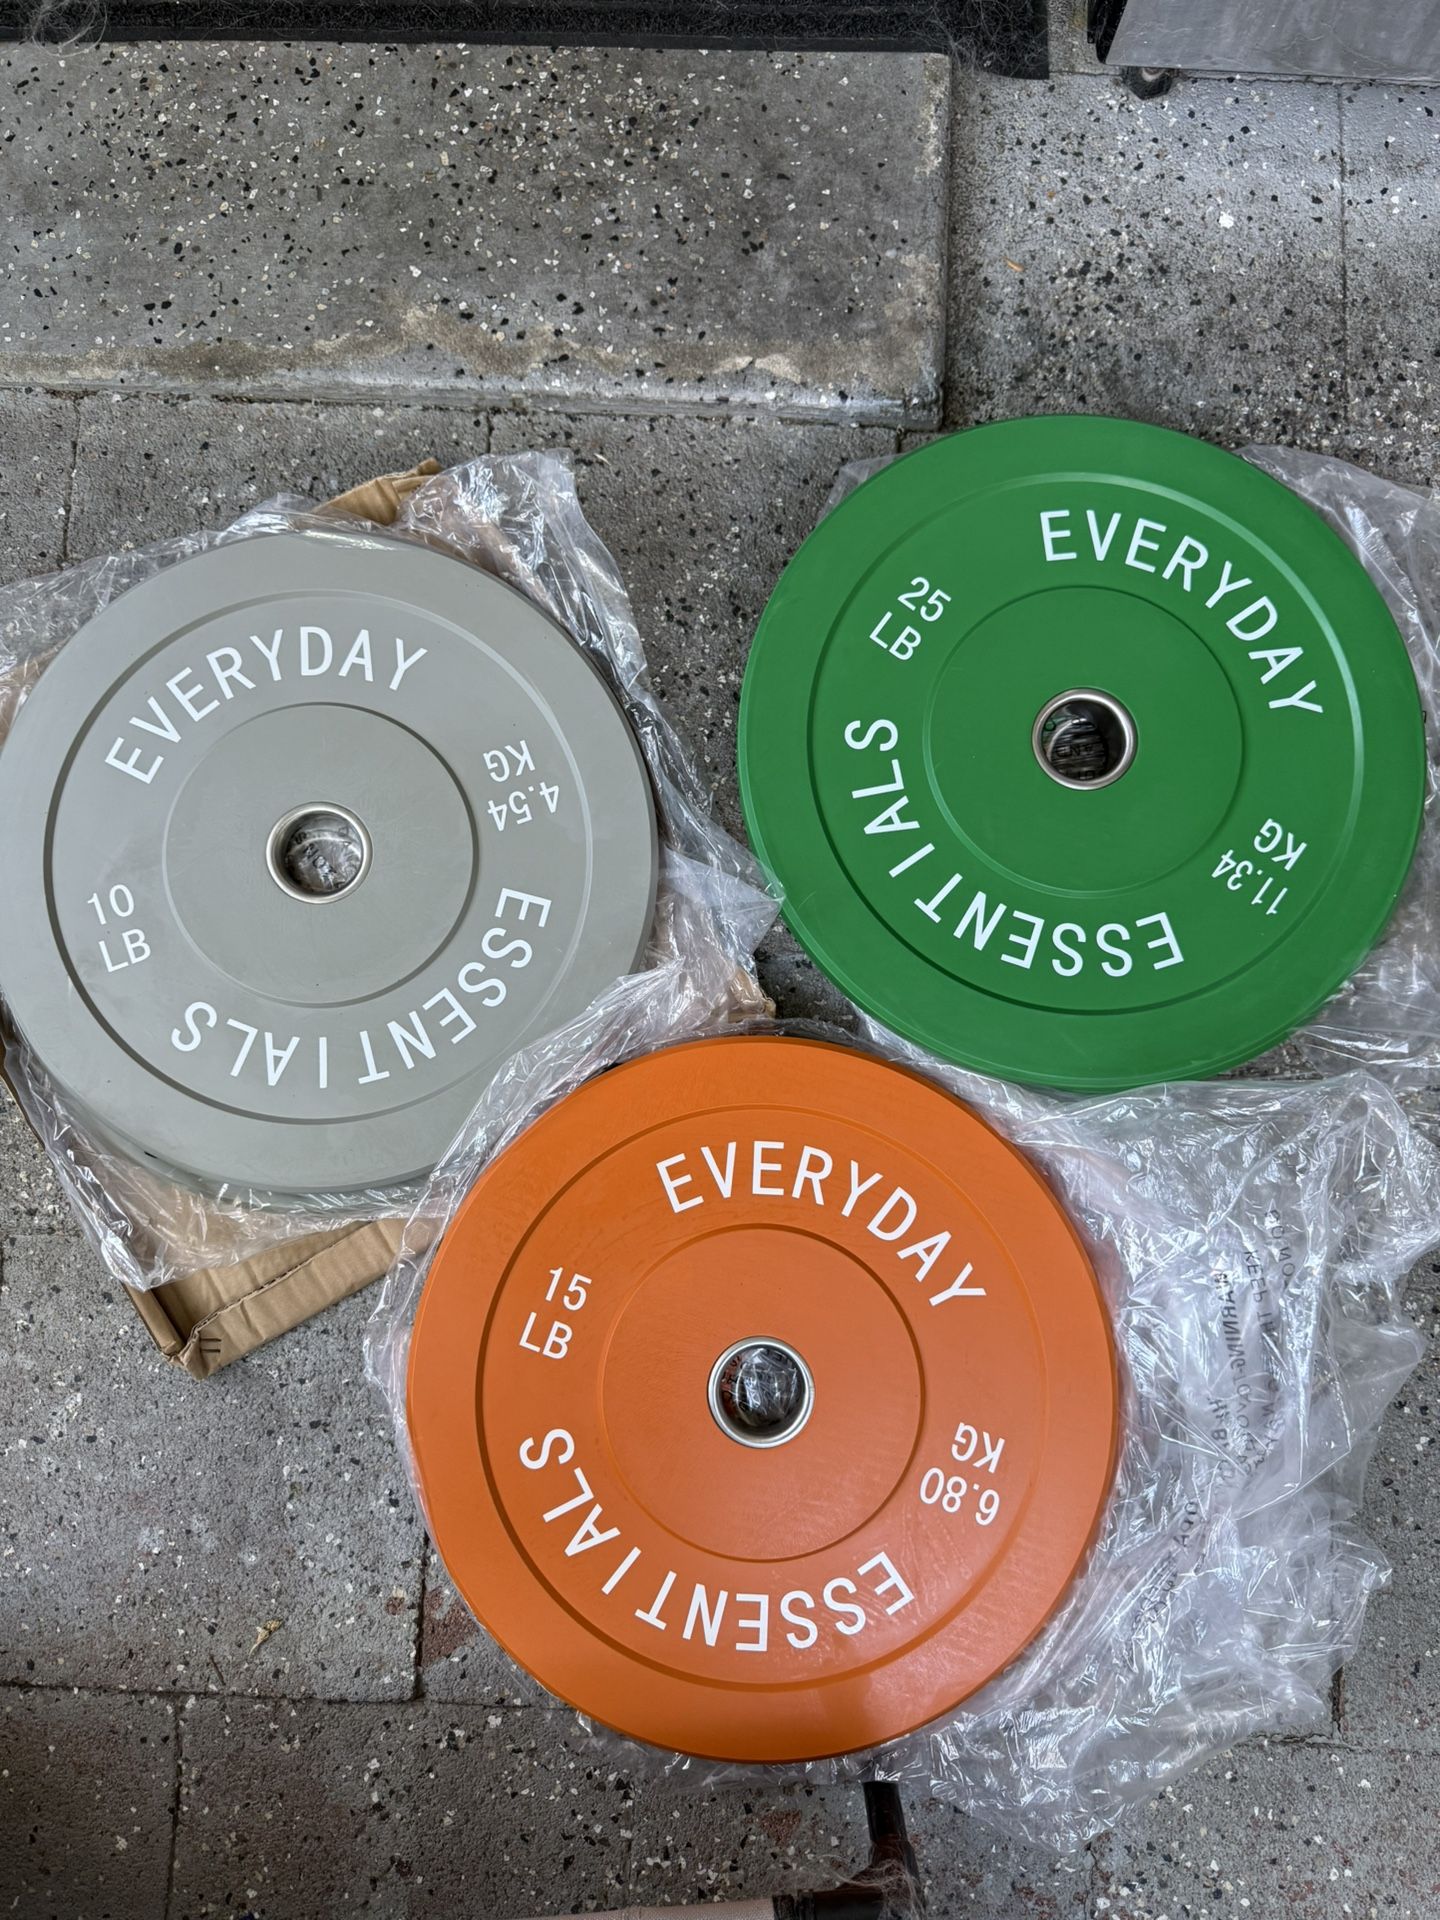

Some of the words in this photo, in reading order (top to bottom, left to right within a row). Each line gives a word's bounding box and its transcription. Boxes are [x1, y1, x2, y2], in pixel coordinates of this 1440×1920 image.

[897, 576, 952, 622] 25
[1040, 510, 1323, 713] EVERYDAY
[869, 611, 922, 660] LB
[104, 626, 428, 785] EVERYDAY
[483, 739, 536, 782] KG
[487, 781, 560, 831] 4.54
[844, 718, 1186, 978] ESSENTIALS
[1252, 818, 1307, 871] KG
[87, 884, 134, 925] 10
[1211, 848, 1288, 916] 11.34
[98, 928, 151, 973] LB
[171, 887, 552, 1089] ESSENTIALS
[656, 1140, 987, 1307] EVERYDAY
[545, 1267, 592, 1311] 15
[519, 1311, 573, 1359] LB
[951, 1422, 1006, 1474] KG
[919, 1466, 1001, 1527] 6.80
[519, 1428, 916, 1653] ESSENTIALS
